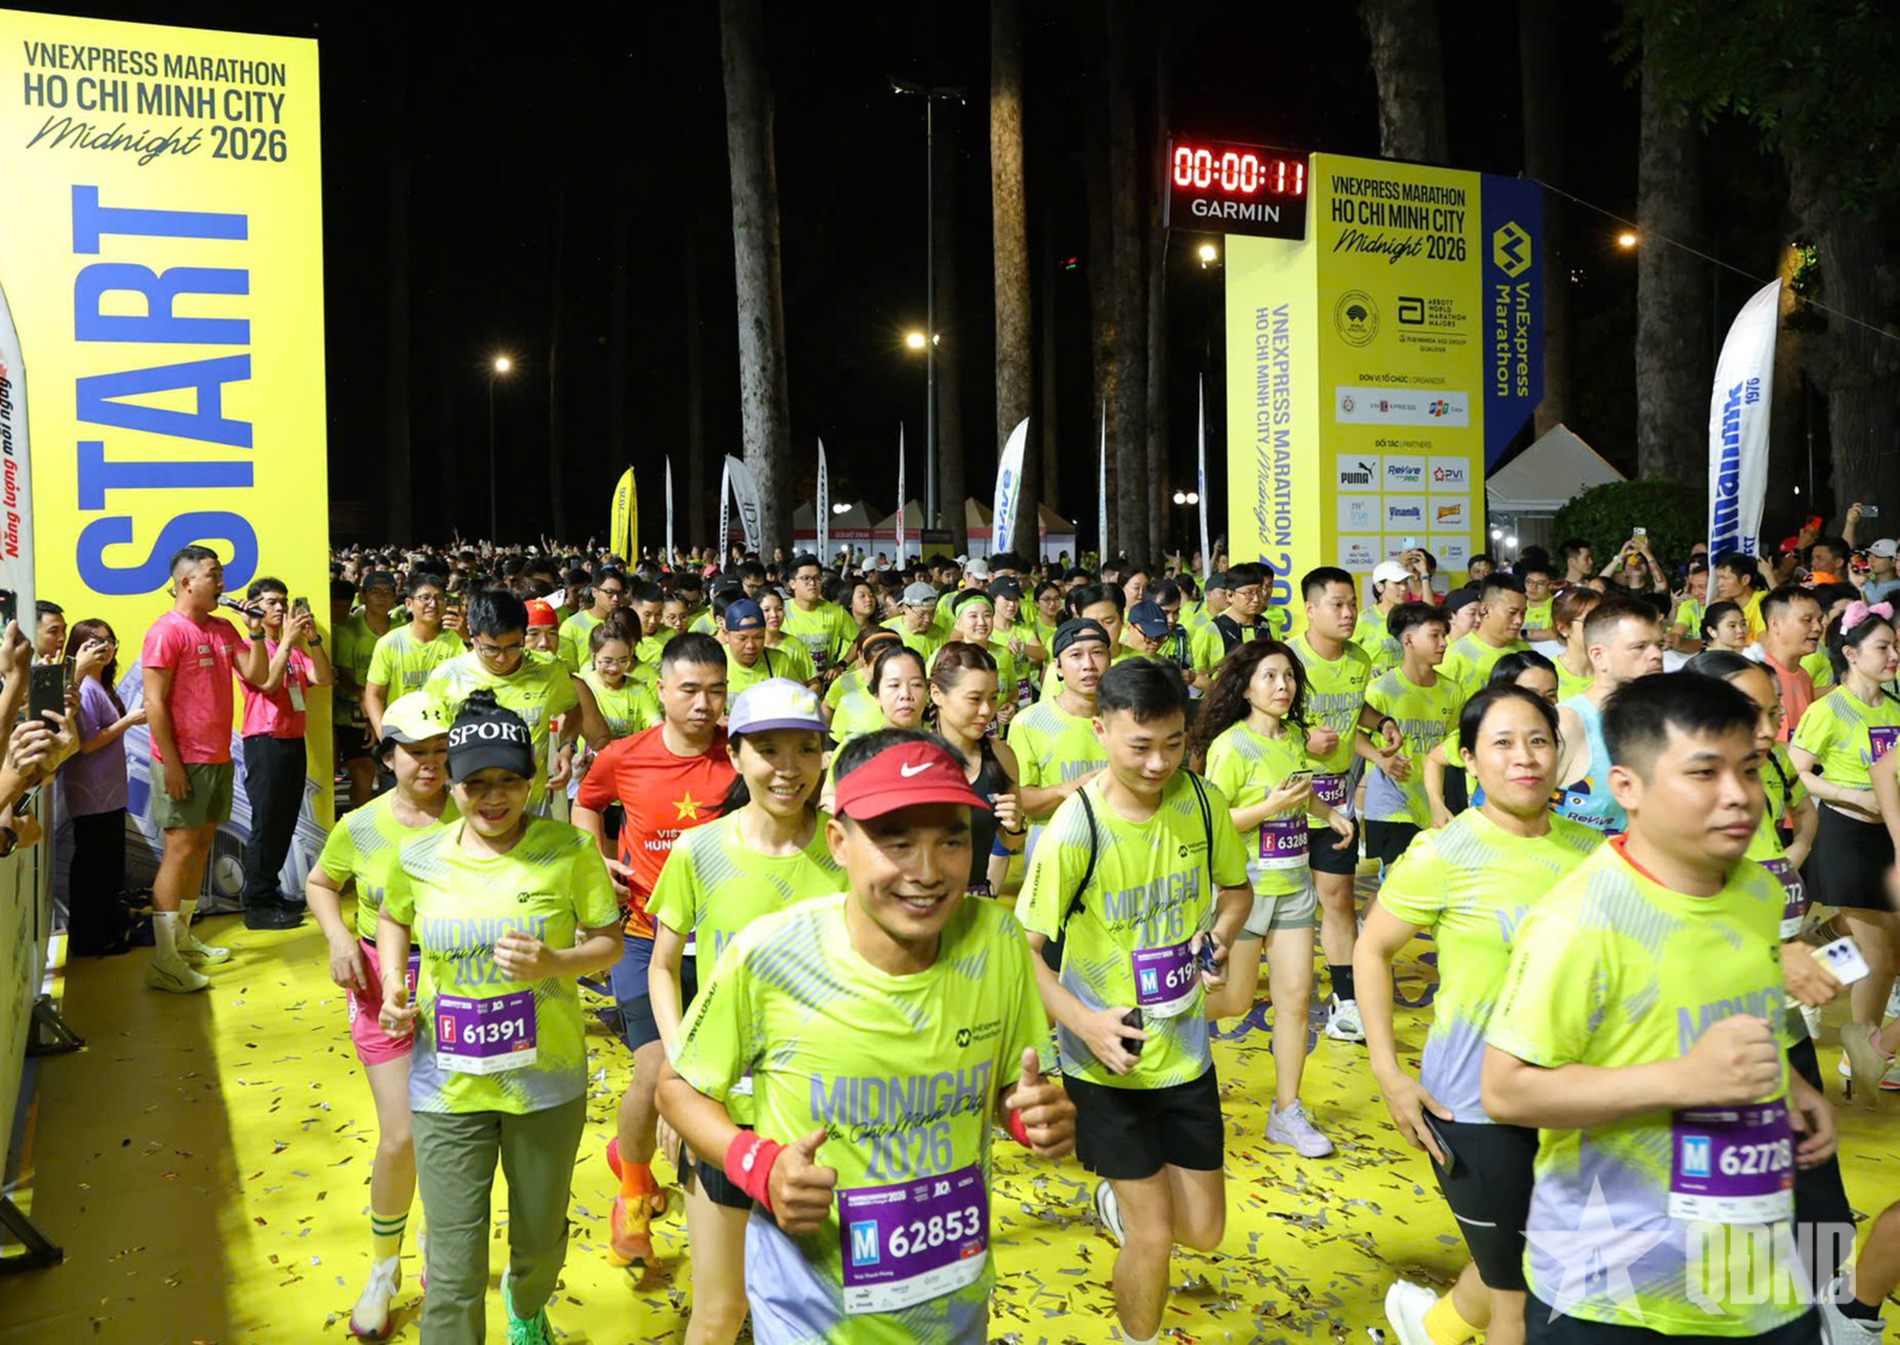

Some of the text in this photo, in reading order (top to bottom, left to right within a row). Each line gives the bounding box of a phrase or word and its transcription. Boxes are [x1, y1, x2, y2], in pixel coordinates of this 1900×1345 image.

[23, 40, 286, 87] VNEXPRESS MARATHON
[24, 72, 285, 124] HO CHI MINH CITY
[26, 115, 287, 166] Midnight 2026
[1174, 147, 1304, 195] 00:00:11
[1332, 175, 1466, 207] VNEXPRESS MARATHON
[1191, 198, 1281, 223] GARMIN
[1332, 198, 1465, 234] HO CHI MINH CITY
[1333, 228, 1466, 264] Midnight 2026
[1256, 307, 1269, 332] HO
[1256, 334, 1269, 362] CHI
[1496, 285, 1512, 397] Marathon
[1514, 282, 1531, 397] VnExpress
[1272, 303, 1290, 425] VNEXPRESS
[72, 184, 259, 596] START
[1256, 364, 1270, 407] MINH
[1745, 376, 1761, 405] 1976
[1257, 410, 1270, 444] CITY
[3, 458, 21, 509] lượng
[1273, 429, 1292, 546] MARATHON
[1341, 472, 1369, 484] PUMA
[1445, 469, 1463, 479] PVI
[1710, 380, 1744, 567] Vinamilk
[3, 510, 22, 559] Năng
[449, 722, 527, 747] SPORT
[1266, 835, 1272, 849] F
[1141, 973, 1156, 995] M
[443, 1019, 452, 1039] F
[463, 1018, 525, 1045] 61391
[811, 1060, 993, 1126] MIDNIGHT
[859, 1120, 953, 1181] 2026
[1683, 1141, 1709, 1171] M
[853, 1227, 877, 1261] M
[888, 1205, 981, 1258] 62853
